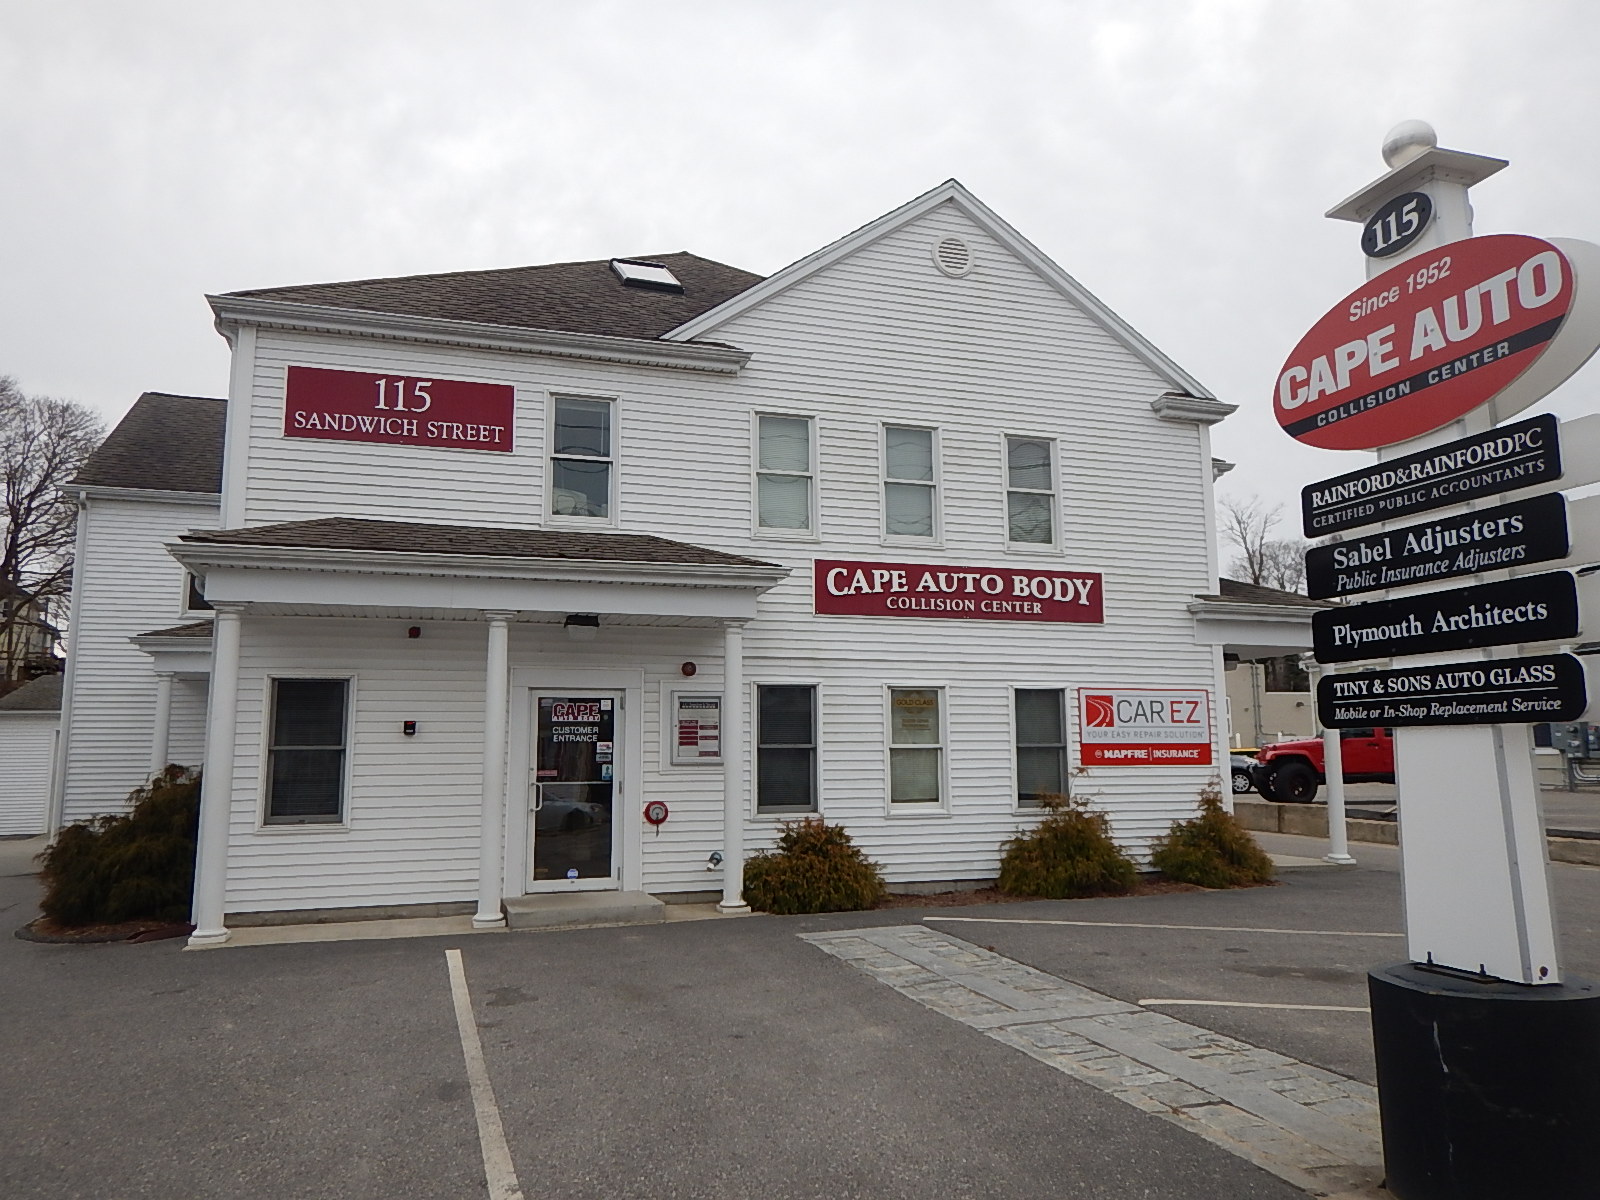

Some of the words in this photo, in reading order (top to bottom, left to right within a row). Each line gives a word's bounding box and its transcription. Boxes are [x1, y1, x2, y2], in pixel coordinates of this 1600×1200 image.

[1372, 198, 1419, 252] 115
[1349, 286, 1399, 322] Since
[1406, 256, 1452, 294] 1952
[1279, 323, 1400, 410] CAPE
[1409, 250, 1563, 361] AUTO
[374, 378, 433, 413] 115
[1317, 380, 1411, 427] COLLISION
[1428, 341, 1511, 384] CENTER
[294, 411, 419, 437] SANDWICH
[426, 421, 505, 444] STREET
[1312, 503, 1375, 528] CERTIFIED
[1379, 490, 1426, 512] PUBLIC
[1430, 459, 1545, 499] ACCOUNTANTS
[1333, 537, 1393, 569] Sabel
[1402, 514, 1524, 556] Adjusters
[1336, 571, 1378, 592] Public
[1380, 559, 1450, 584] Insurance
[1451, 544, 1526, 572] Adjusters
[826, 567, 909, 596] CAPE
[916, 571, 1004, 595] AUTO
[1012, 575, 1094, 606] BODY
[886, 596, 975, 612] COLLISION
[981, 600, 1043, 614] CENTER
[1332, 613, 1424, 648] Plymouth
[1431, 601, 1548, 634] Architects
[1333, 680, 1370, 697] TINY
[1372, 679, 1385, 694] &
[1387, 674, 1432, 693] SONS
[1435, 670, 1485, 690] AUTO
[1489, 664, 1556, 685] GLASS
[552, 703, 600, 719] CAPE
[1116, 699, 1165, 724] CAR
[1169, 700, 1201, 724] EZ
[1334, 706, 1368, 720] Mobile
[1369, 709, 1382, 719] or
[1383, 703, 1428, 720] In-Shop
[1429, 700, 1508, 717] Replacement
[1511, 696, 1562, 712] Service
[552, 726, 599, 734] CUSTOMER
[553, 734, 598, 742] ENTRANCE
[1086, 730, 1108, 738] YOUR
[1112, 730, 1131, 738] EASY
[1134, 730, 1162, 738] REPAIR
[1104, 750, 1149, 759] MAPFRE
[1153, 750, 1199, 759] INSURANCE
